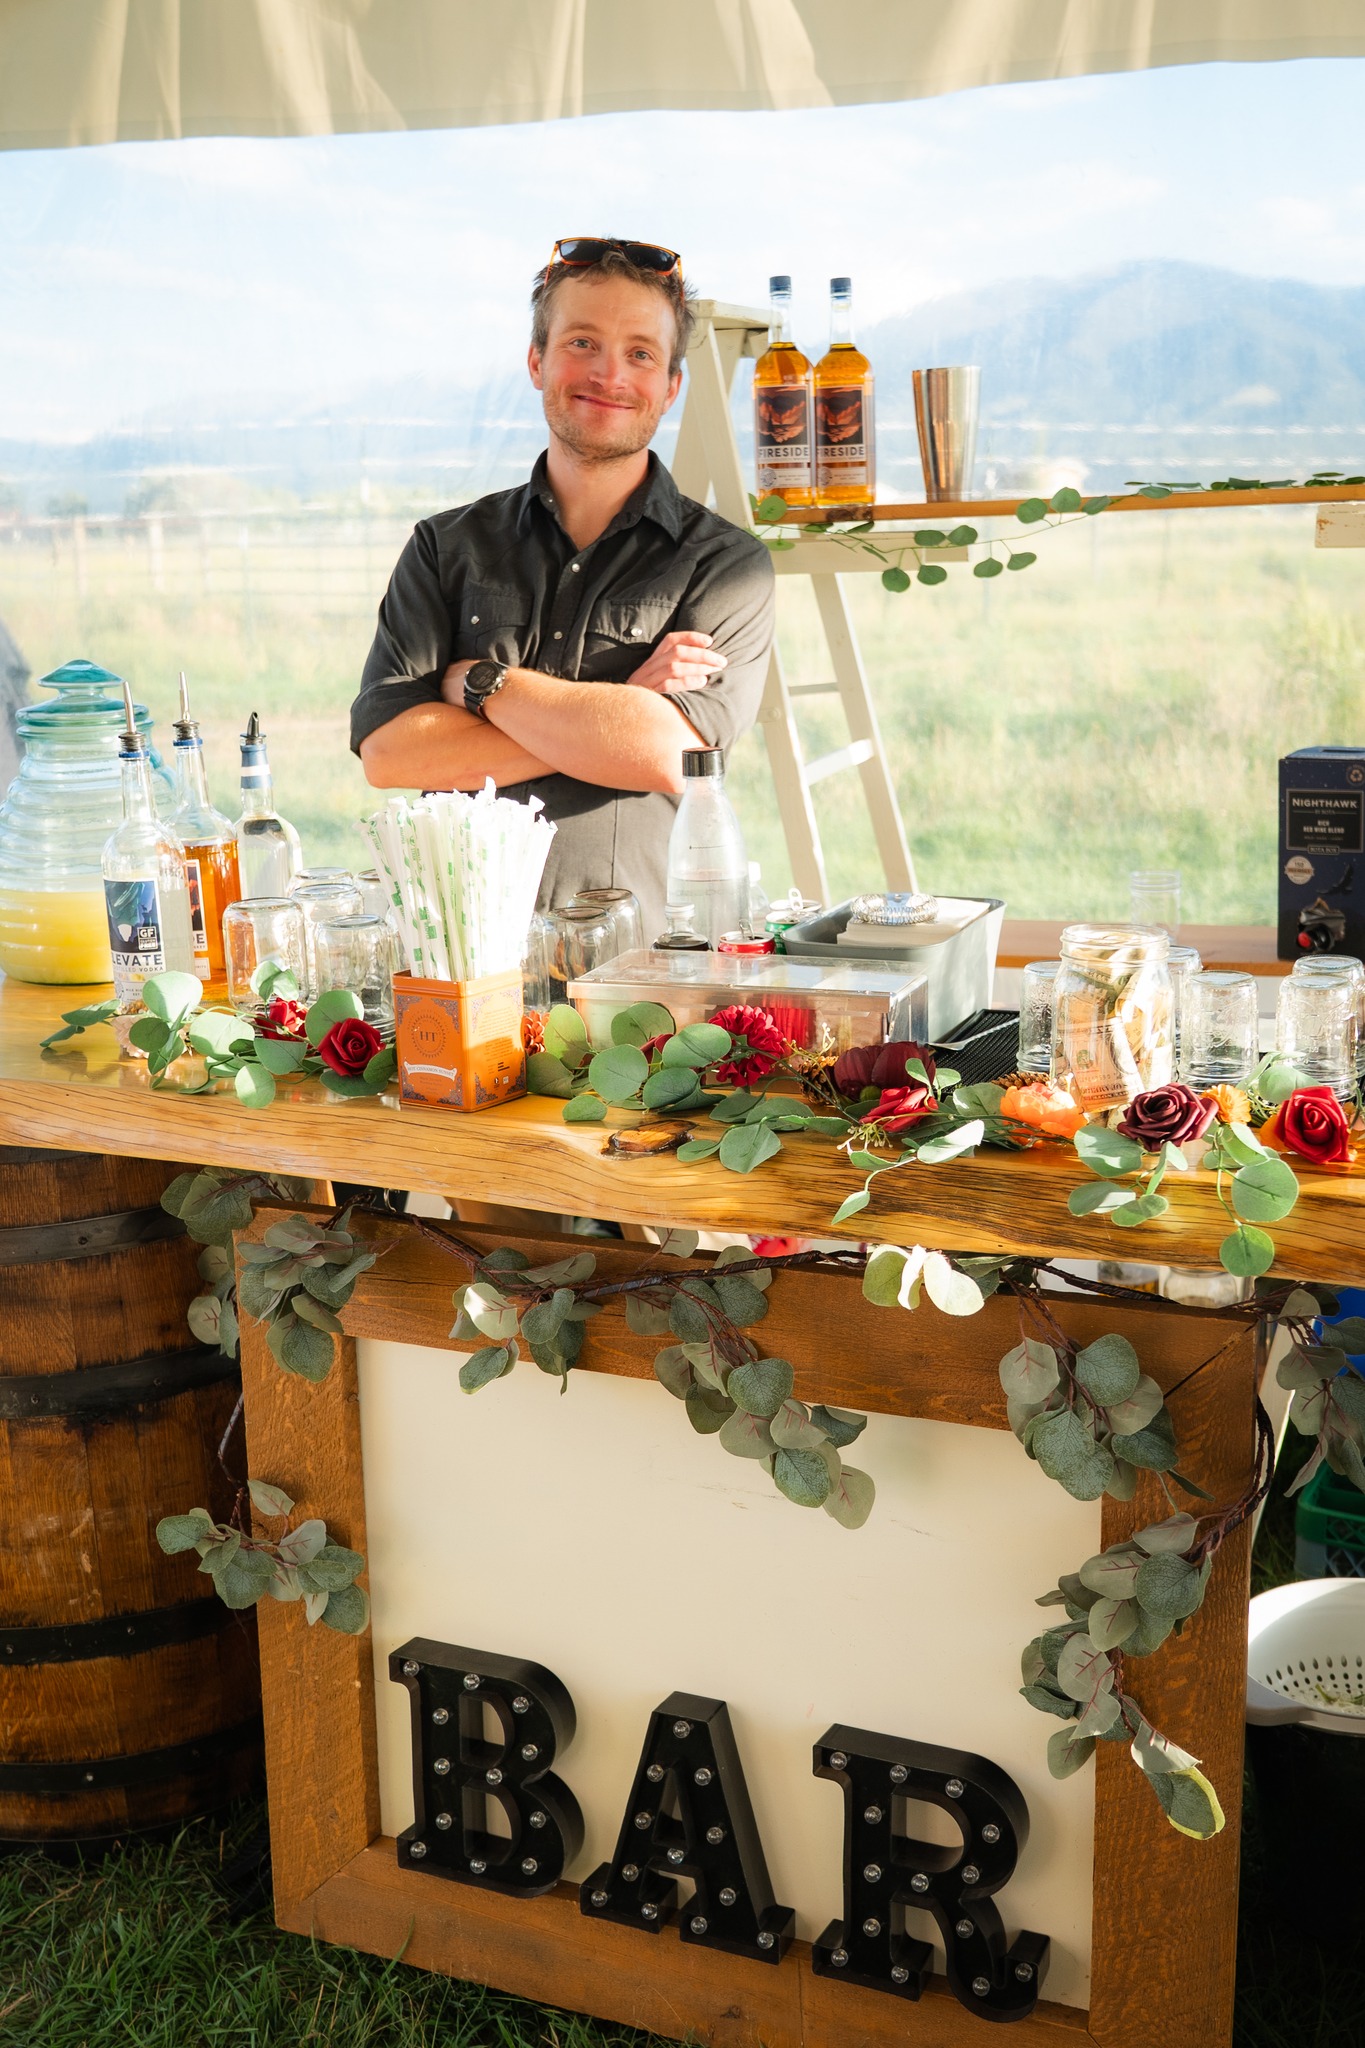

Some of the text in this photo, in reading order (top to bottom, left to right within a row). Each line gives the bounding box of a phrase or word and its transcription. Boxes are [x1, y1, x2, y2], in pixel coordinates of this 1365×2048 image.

[758, 447, 809, 457] FIRESIDE
[1292, 798, 1357, 808] NIGHTHAWK
[1314, 826, 1327, 834] WINE
[139, 928, 155, 938] GF
[389, 1637, 1050, 2023] BAR
